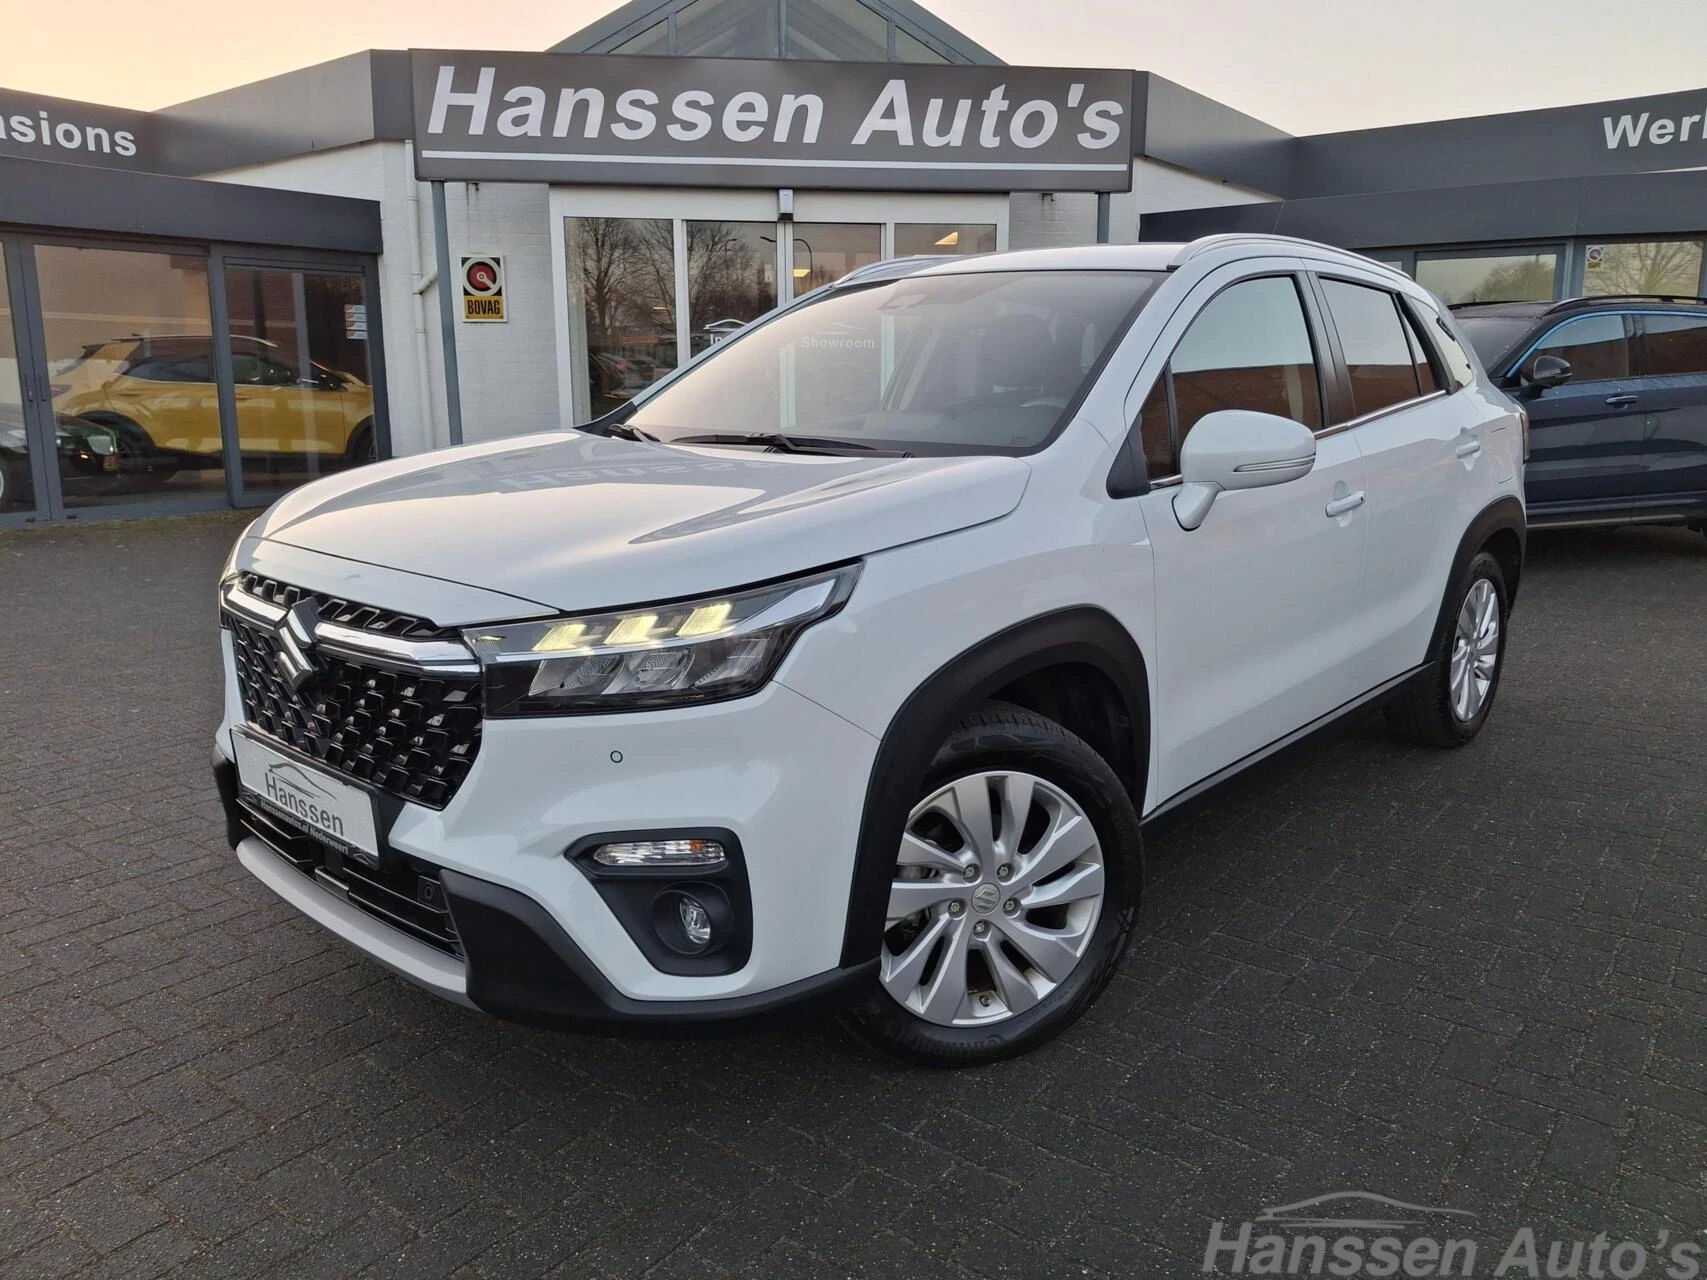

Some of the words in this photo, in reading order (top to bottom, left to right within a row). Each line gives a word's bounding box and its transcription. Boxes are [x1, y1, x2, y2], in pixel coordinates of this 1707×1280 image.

[427, 65, 824, 145] Hanssen
[852, 79, 1123, 150] Auto's
[1603, 108, 1707, 149] Wer
[0, 110, 137, 156] sions
[467, 300, 501, 315] BOVAG
[800, 336, 875, 349] Showroom
[264, 772, 344, 836] Hanssen
